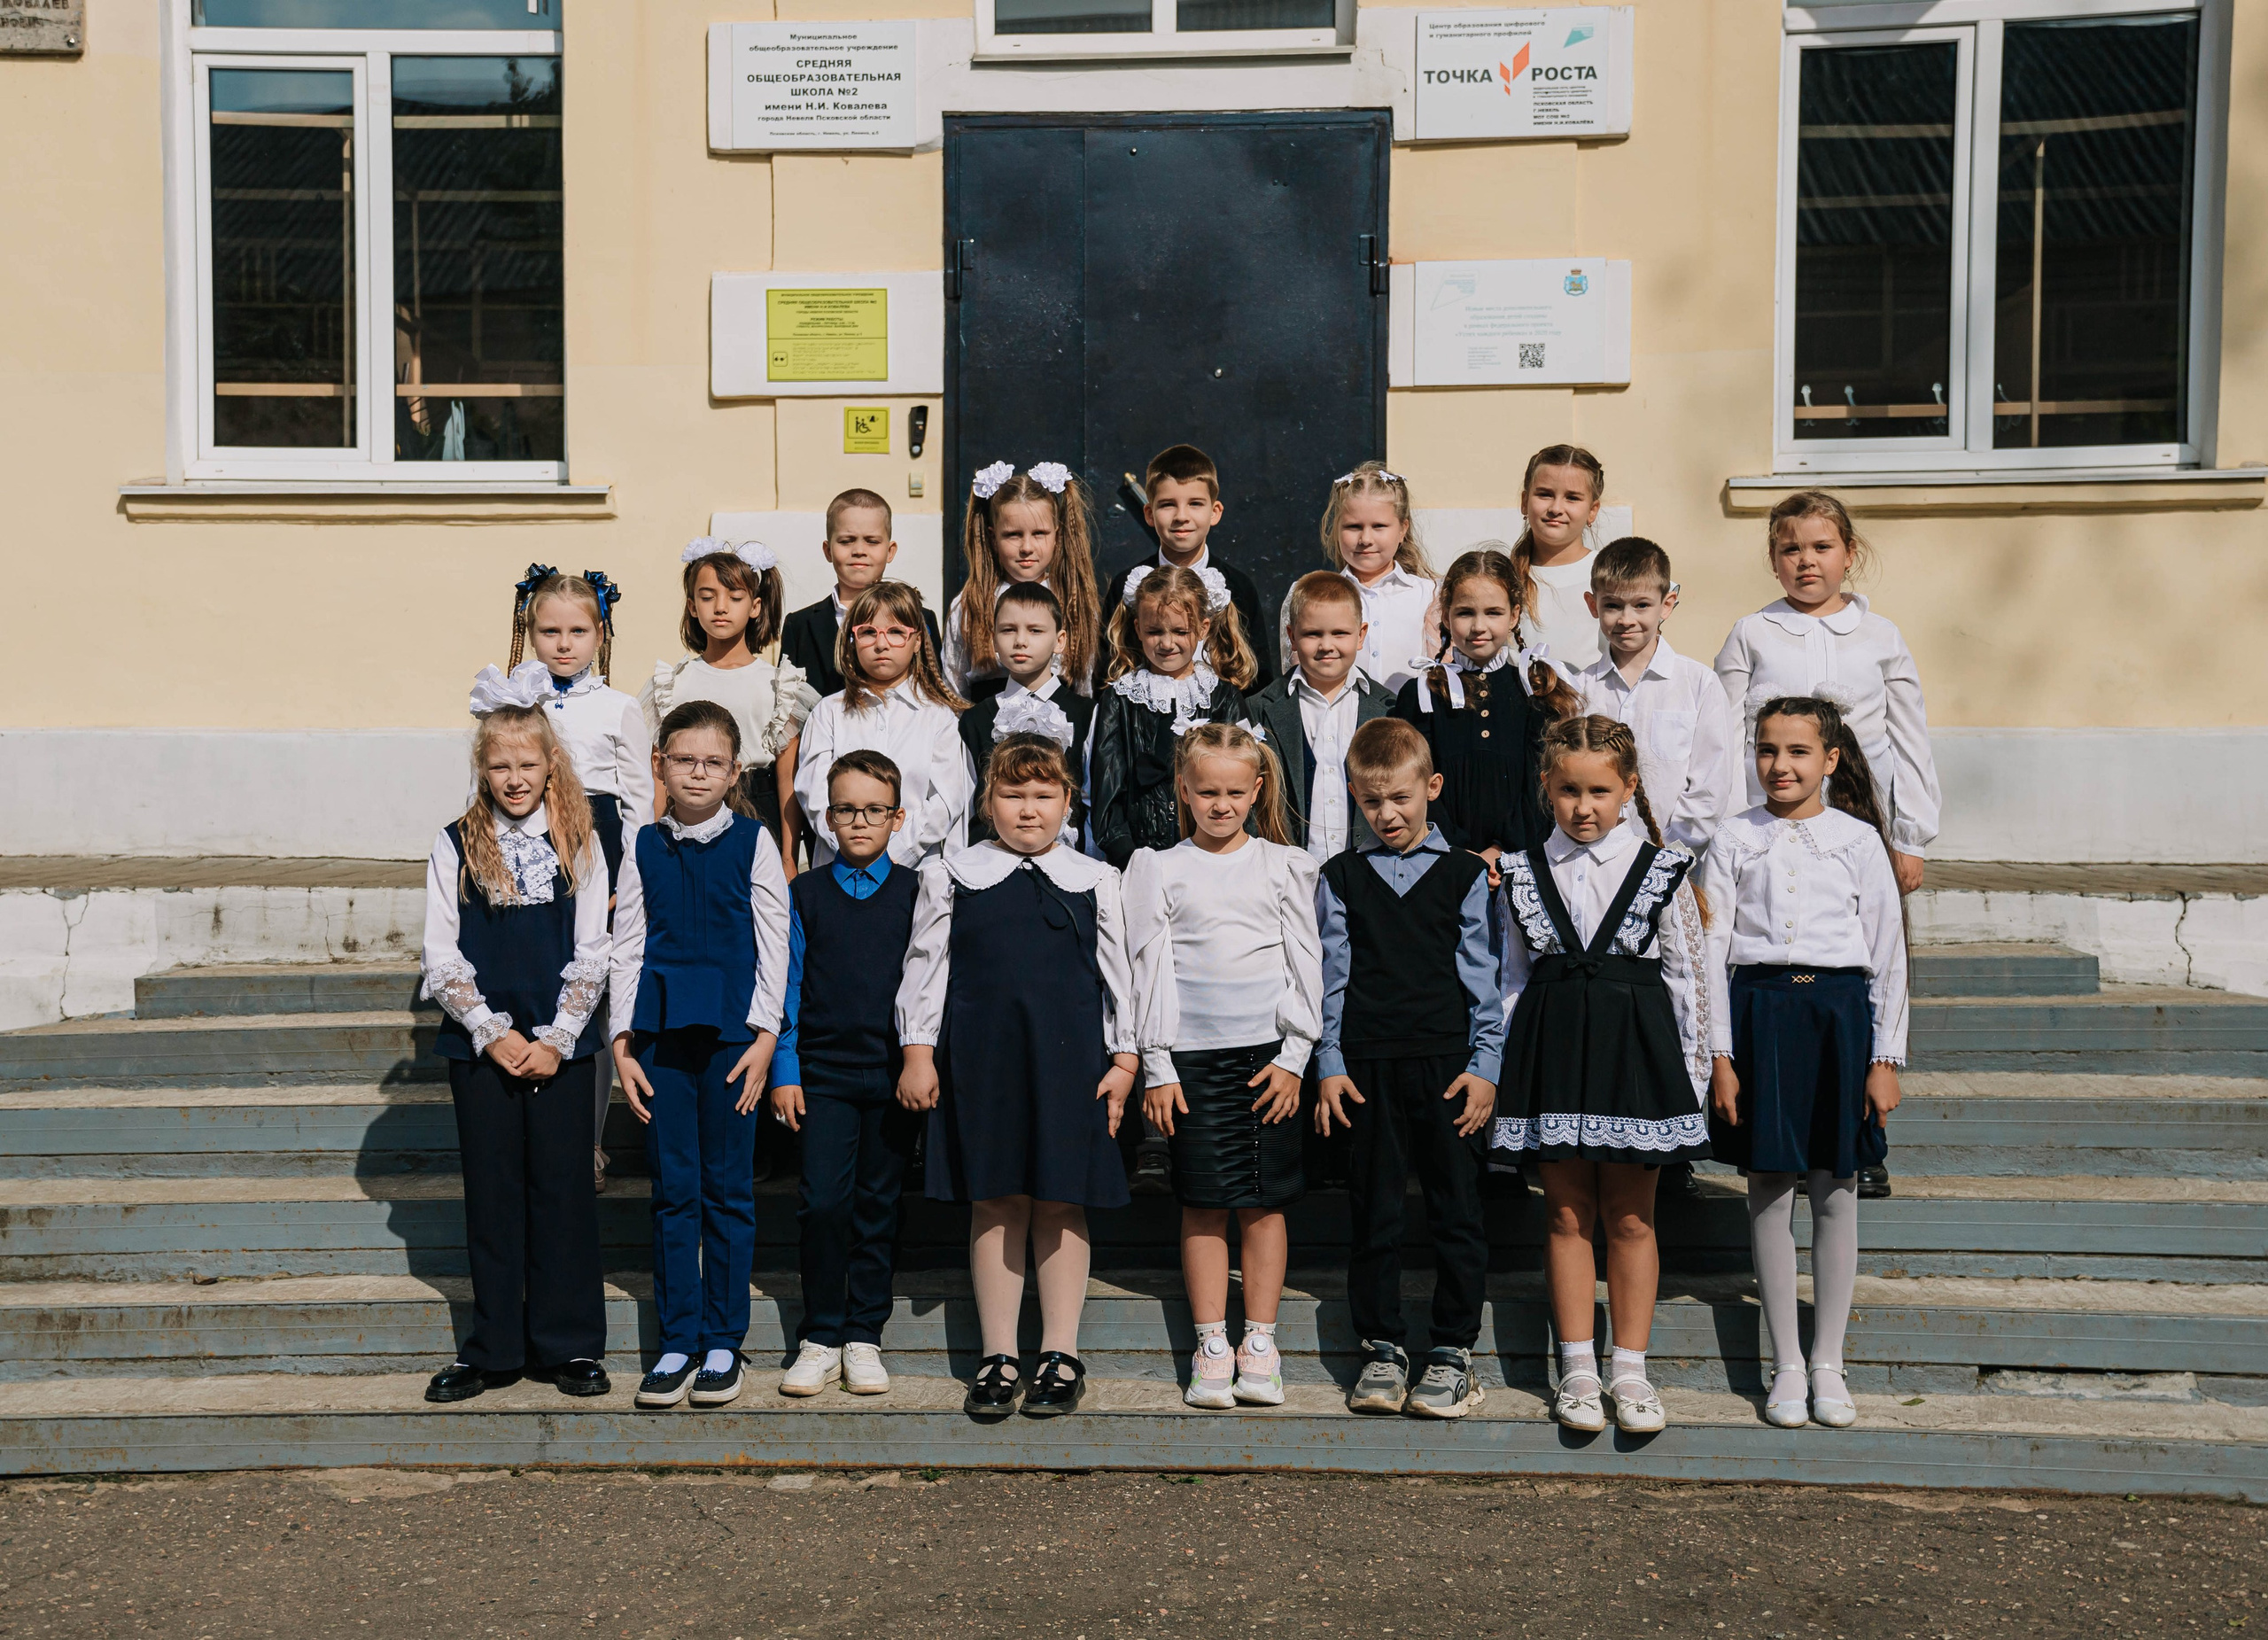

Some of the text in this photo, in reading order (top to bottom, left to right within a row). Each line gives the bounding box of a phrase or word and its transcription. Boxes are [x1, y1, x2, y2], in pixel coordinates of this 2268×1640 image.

[796, 59, 852, 69] СРЕДНЯЯ
[747, 73, 902, 83] ОБЩЕОБРАЗОВАТЕЛЬНАЯ
[1424, 66, 1597, 84] ТОЧКА РОСТА
[790, 88, 834, 97] ШКОЛА
